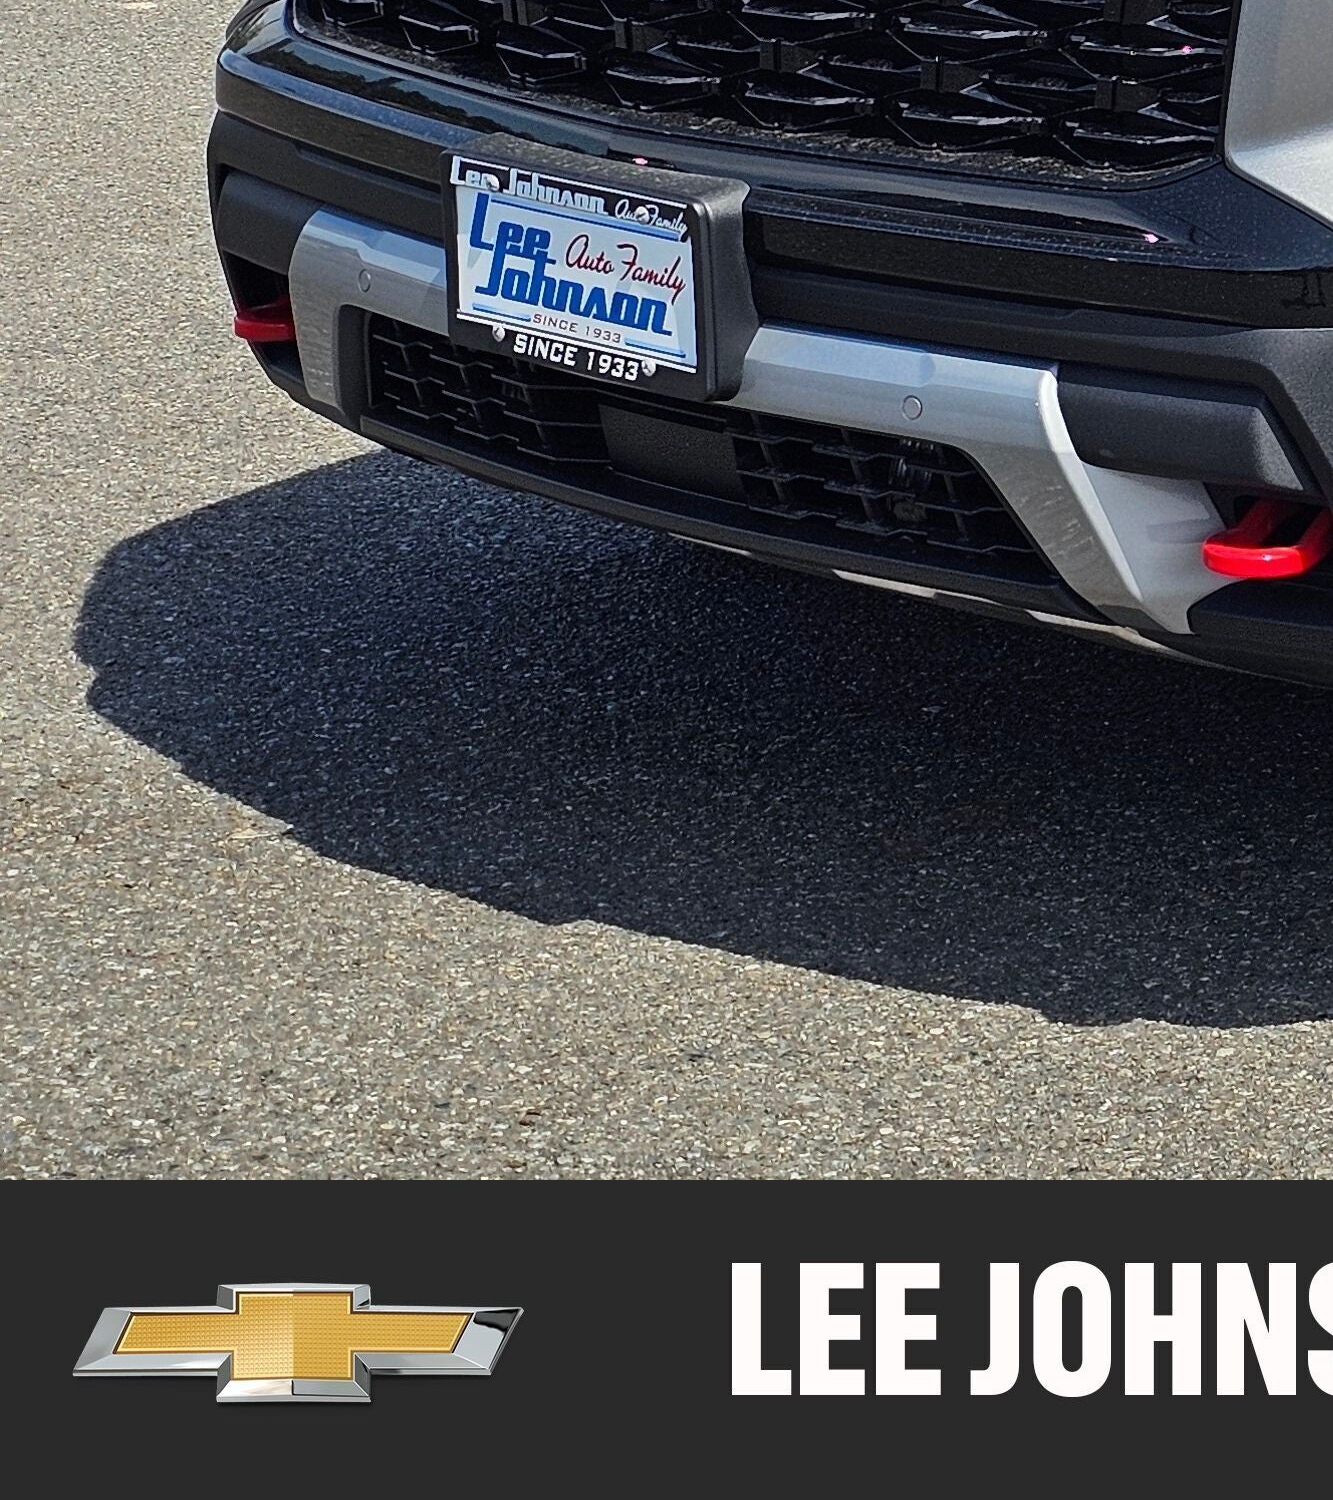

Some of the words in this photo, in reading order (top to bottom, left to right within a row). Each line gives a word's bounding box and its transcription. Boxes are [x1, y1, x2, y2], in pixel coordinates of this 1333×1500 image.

[469, 193, 556, 265] Lee
[503, 167, 609, 217] Johnson
[647, 204, 688, 242] Family
[475, 248, 674, 336] Johnson
[565, 234, 615, 276] Auto
[616, 243, 687, 306] Family
[512, 334, 577, 368] SINCE
[586, 351, 641, 382] 1933
[532, 313, 579, 335] SINCE
[584, 324, 623, 345] 1933
